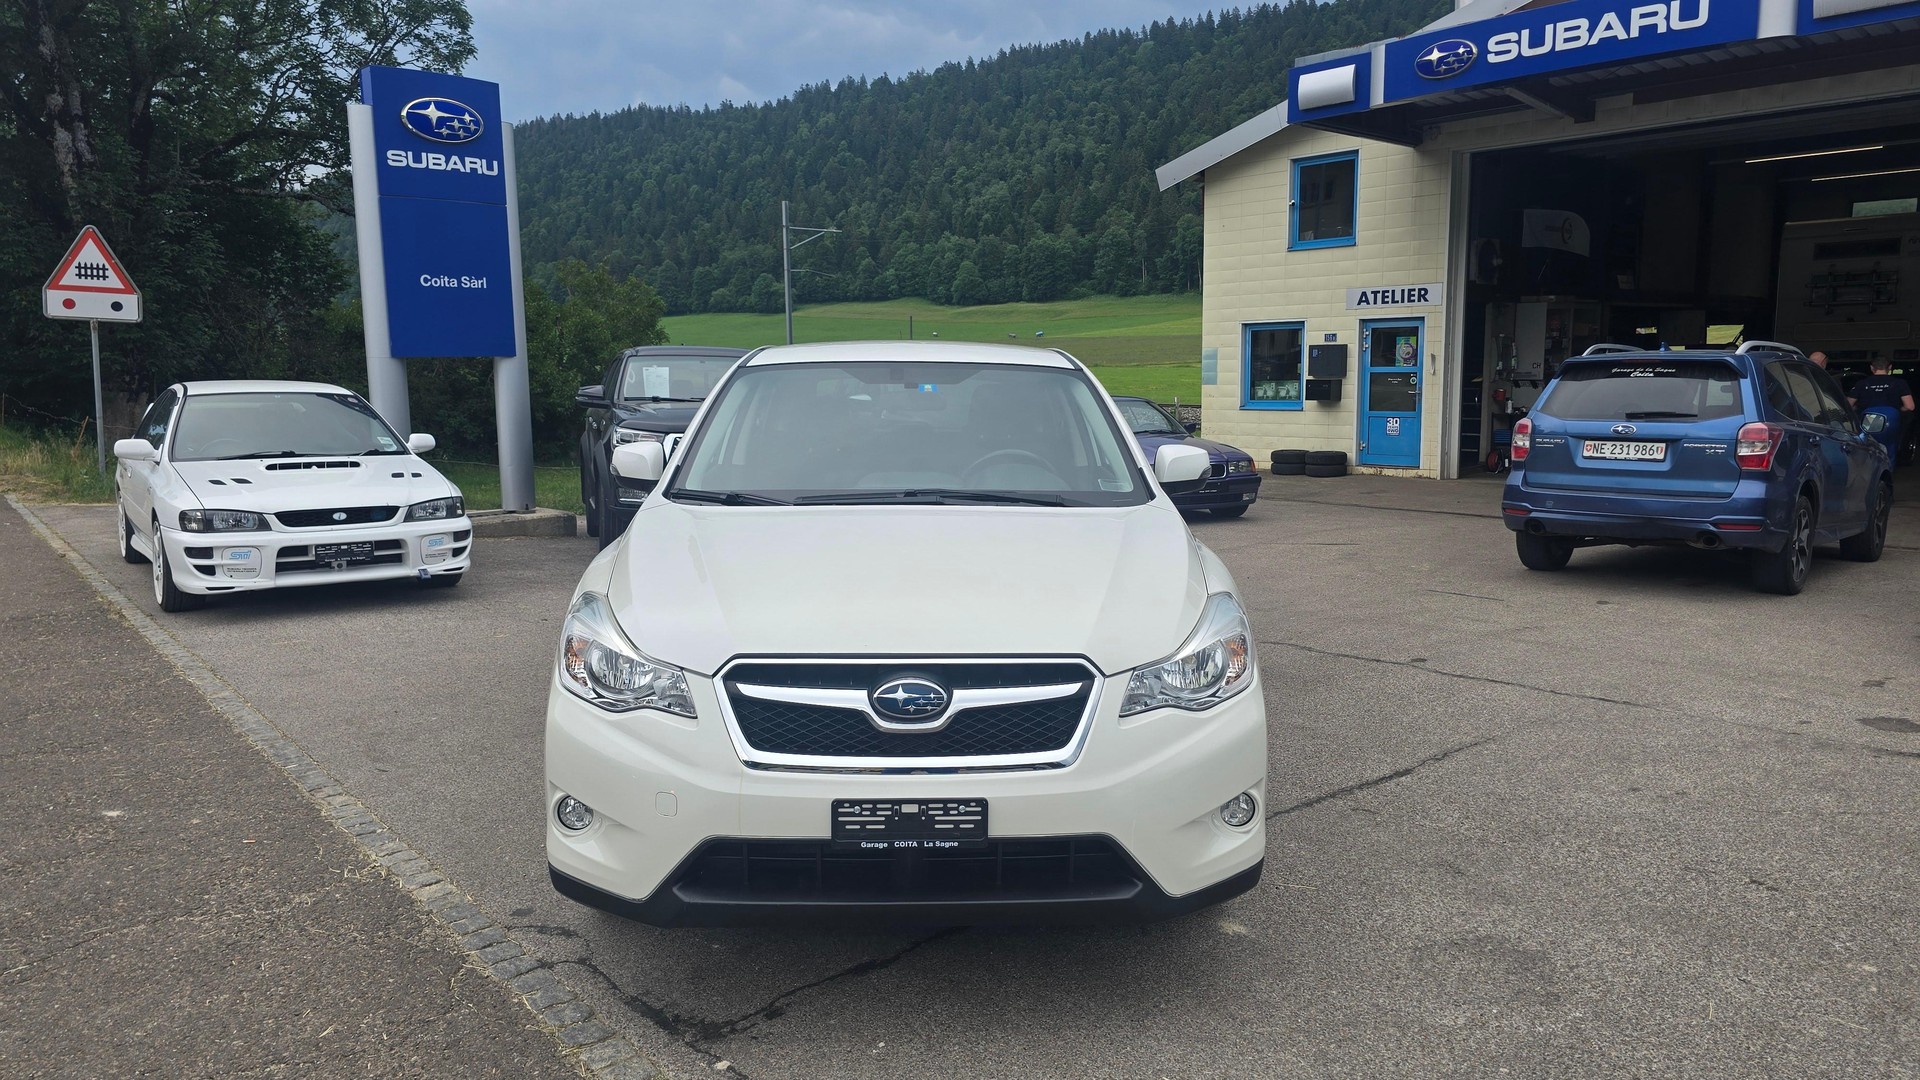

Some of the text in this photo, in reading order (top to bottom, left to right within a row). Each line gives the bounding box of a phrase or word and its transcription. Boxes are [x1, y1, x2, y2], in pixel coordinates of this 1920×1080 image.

[1486, 0, 1711, 64] SUBARU
[387, 149, 499, 176] SUBARU
[420, 274, 487, 289] Coita Sàrl
[1356, 287, 1430, 306] ATELIER
[860, 841, 888, 849] Garage
[935, 841, 959, 849] Sagne
